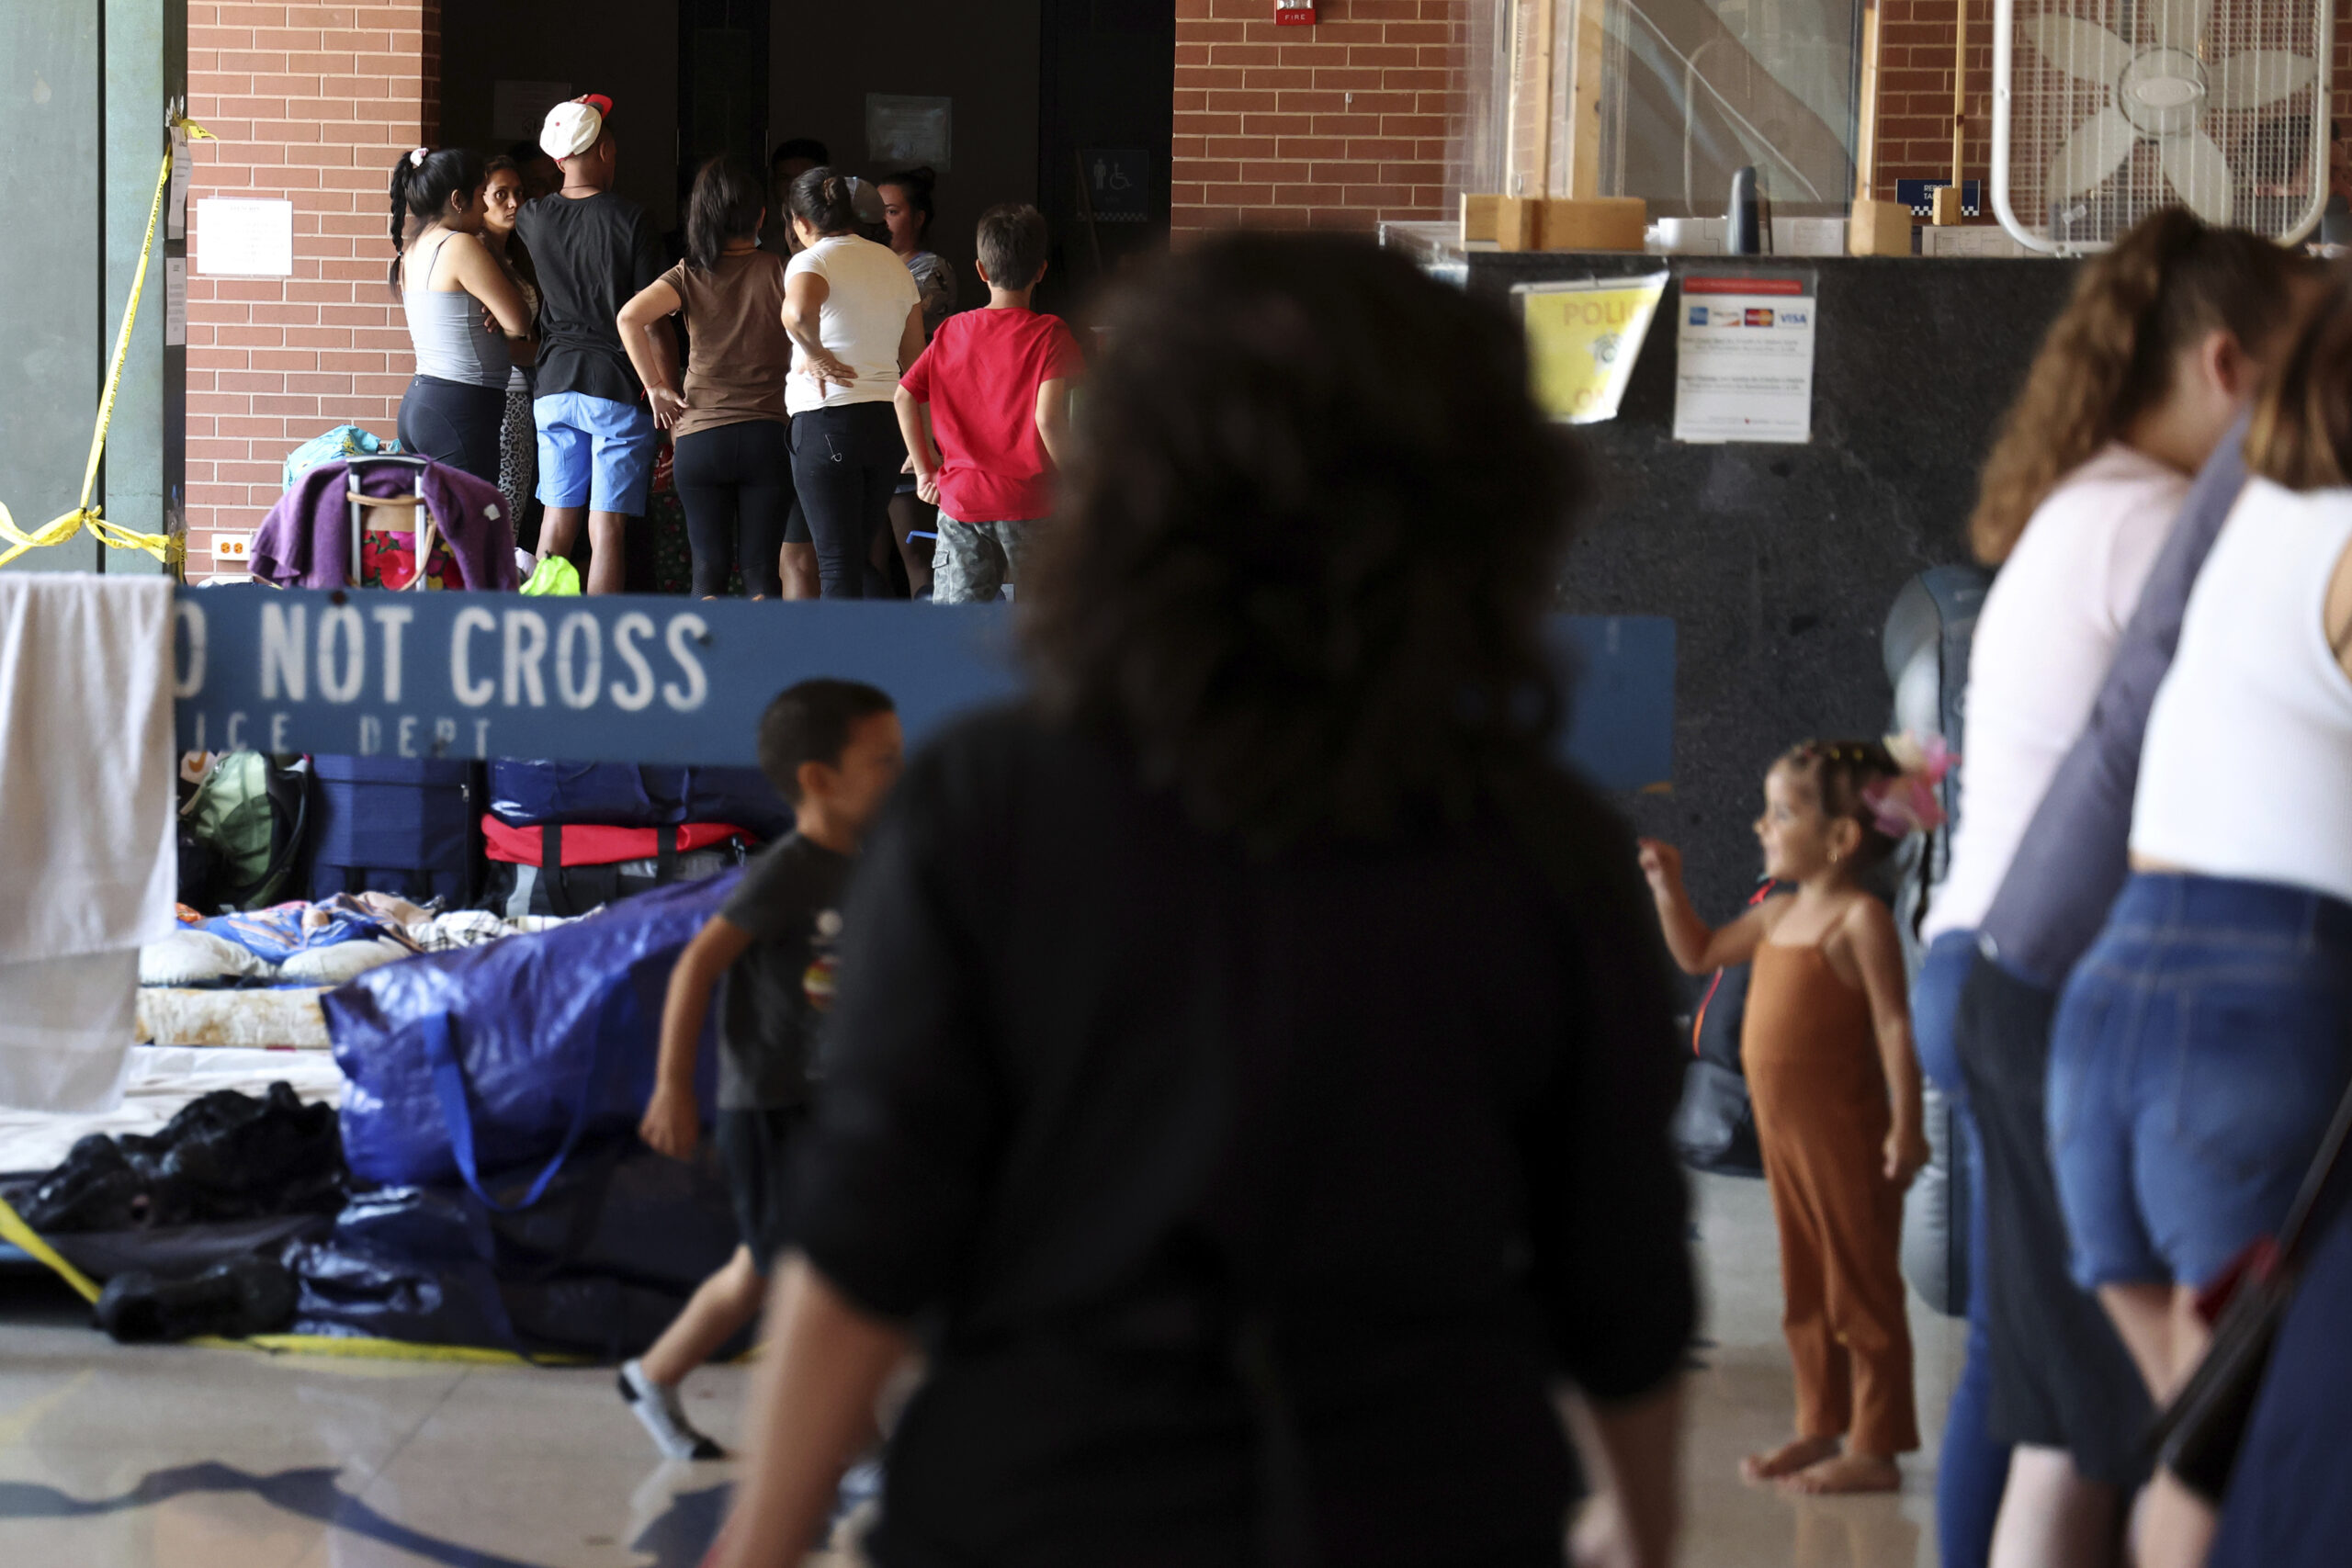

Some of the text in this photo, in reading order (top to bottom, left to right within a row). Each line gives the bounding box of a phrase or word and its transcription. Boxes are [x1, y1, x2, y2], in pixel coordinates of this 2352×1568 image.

[1563, 299, 1635, 326] POLI
[1781, 313, 1807, 323] VISA
[174, 600, 708, 712] O NOT CROSS
[194, 713, 490, 759] ICE DEPT
